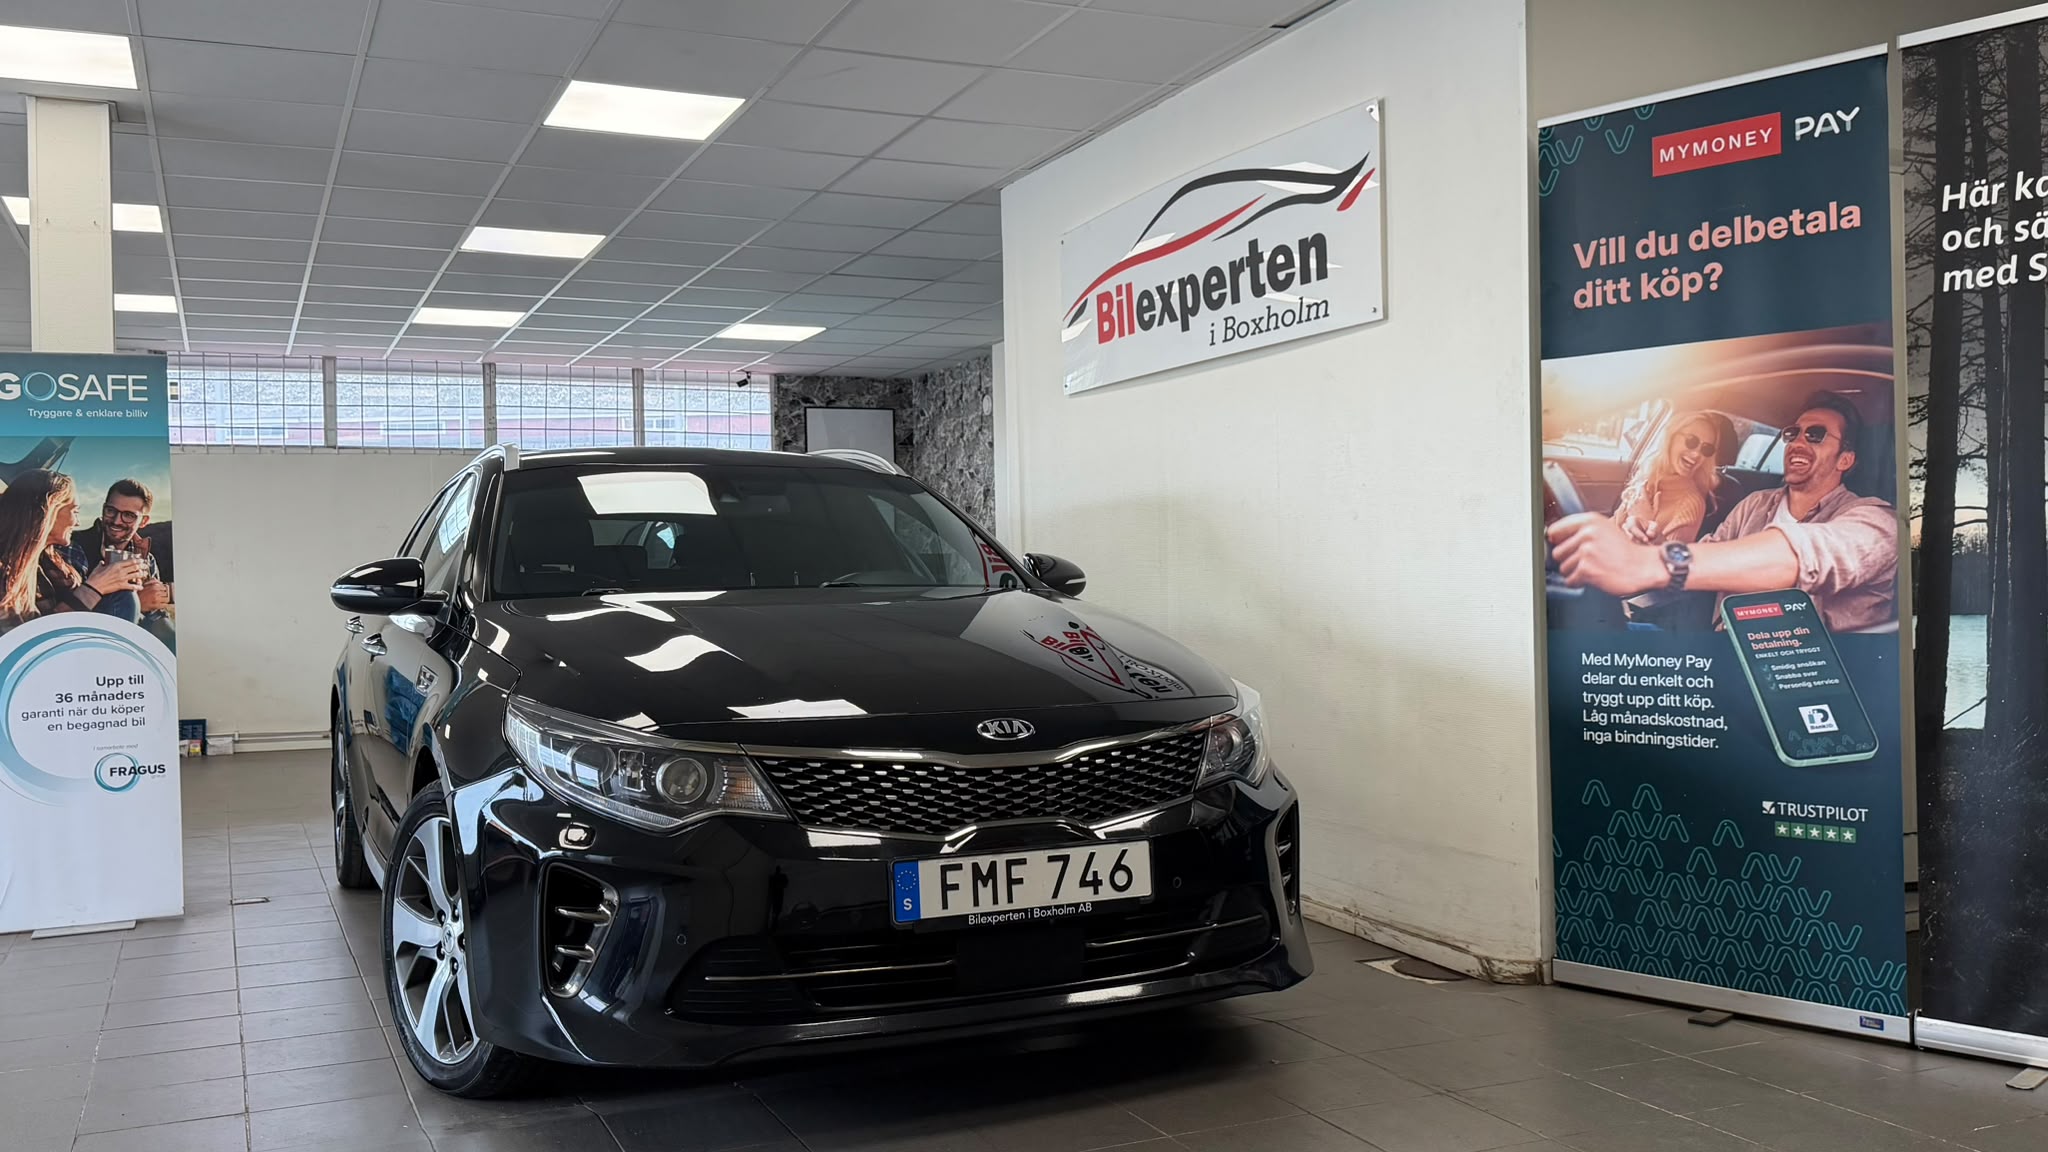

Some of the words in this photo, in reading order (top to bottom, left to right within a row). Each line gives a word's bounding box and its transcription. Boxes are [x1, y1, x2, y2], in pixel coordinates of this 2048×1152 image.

[1659, 127, 1773, 163] MYMONEY
[1795, 106, 1860, 141] PAY
[1942, 179, 2005, 212] Här
[1573, 235, 1626, 269] Vill
[1635, 230, 1678, 260] du
[1688, 201, 1861, 252] delbetala
[1942, 217, 2004, 252] och
[1943, 254, 2018, 292] med
[1096, 232, 1329, 344] Bilexperten
[1573, 277, 1631, 309] ditt
[1641, 262, 1723, 302] köp?
[1209, 323, 1216, 346] i
[1222, 296, 1330, 344] Boxholm
[28, 408, 72, 419] Tryggare
[76, 409, 83, 417] &
[86, 409, 123, 418] enklare
[126, 409, 148, 418] billiv
[1737, 607, 1780, 617] MYMONEY
[1784, 602, 1807, 611] PAY
[1747, 631, 1771, 640] Dela
[1772, 630, 1792, 639] upp
[1793, 627, 1810, 635] din
[1751, 639, 1802, 650] betalning.
[1581, 652, 1611, 666] Med
[1614, 653, 1682, 670] MyMoney
[1686, 655, 1712, 672] Pay
[96, 676, 124, 688] Upp
[128, 675, 144, 685] till
[1582, 671, 1616, 685] delar
[1619, 673, 1637, 685] du
[1640, 674, 1683, 687] enkelt
[1686, 675, 1713, 688] och
[55, 693, 73, 703] 36
[78, 691, 144, 703] månaders
[1582, 691, 1624, 707] tryggt
[1627, 694, 1654, 708] upp
[1657, 693, 1681, 707] ditt
[1684, 694, 1715, 711] köp.
[21, 709, 64, 721] garanti
[68, 708, 87, 716] när
[91, 705, 107, 715] du
[111, 704, 145, 716] köper
[1583, 709, 1607, 726] Låg
[1611, 711, 1728, 731] månadskostnad,
[47, 723, 62, 731] en
[67, 718, 128, 732] begagnad
[131, 717, 146, 727] bil
[986, 720, 1028, 735] KIA
[1583, 728, 1612, 744] inga
[1615, 730, 1719, 749] bindningstider.
[110, 764, 166, 777] FRAGUS
[1777, 802, 1869, 822] TRUSTPILOT
[940, 857, 1027, 910] FMF
[1047, 849, 1133, 899] 746
[903, 898, 912, 911] S
[968, 910, 1026, 925] Bilexperten
[1028, 908, 1031, 919] i
[1033, 904, 1076, 918] Boxholm
[1078, 902, 1093, 914] AB
